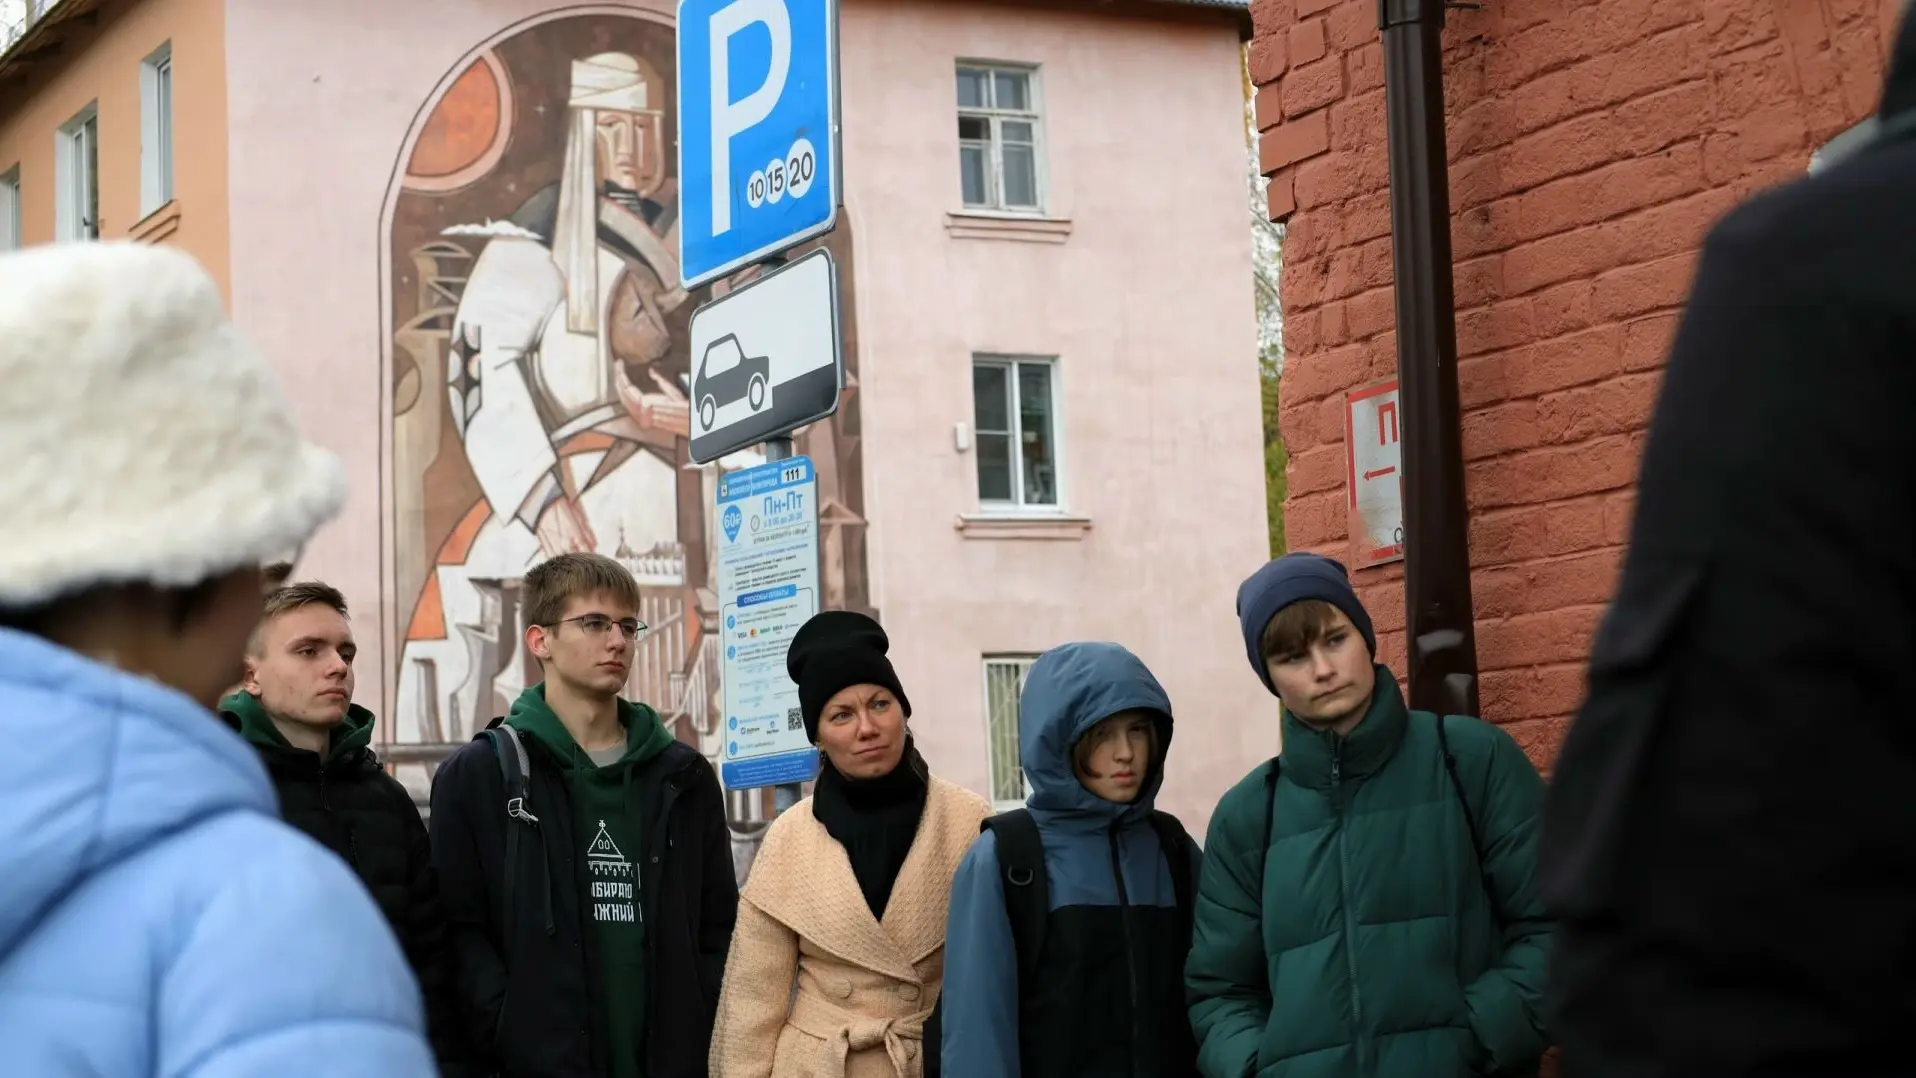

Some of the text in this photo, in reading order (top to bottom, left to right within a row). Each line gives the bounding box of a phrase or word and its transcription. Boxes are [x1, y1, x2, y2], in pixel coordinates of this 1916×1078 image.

[709, 0, 791, 238] P
[749, 151, 813, 202] 10 15 20
[785, 467, 800, 482] 111
[763, 490, 803, 516] Пн-Пт
[591, 881, 633, 899] БИРАЮ
